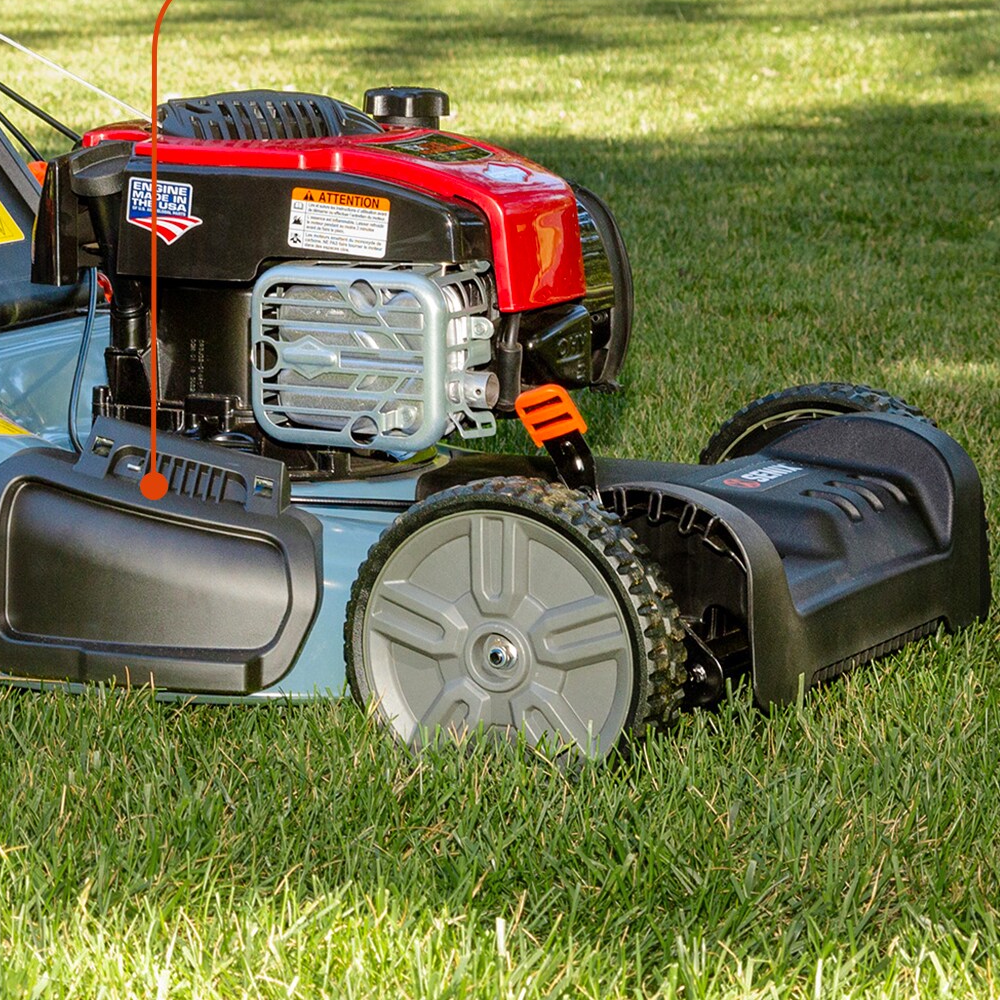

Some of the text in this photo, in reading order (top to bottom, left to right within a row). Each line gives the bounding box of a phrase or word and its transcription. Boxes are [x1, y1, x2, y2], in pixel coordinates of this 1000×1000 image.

[132, 190, 187, 206] MADE IN
[318, 192, 380, 209] ATTENTION
[158, 201, 187, 213] USA
[740, 463, 804, 483] SENIX
